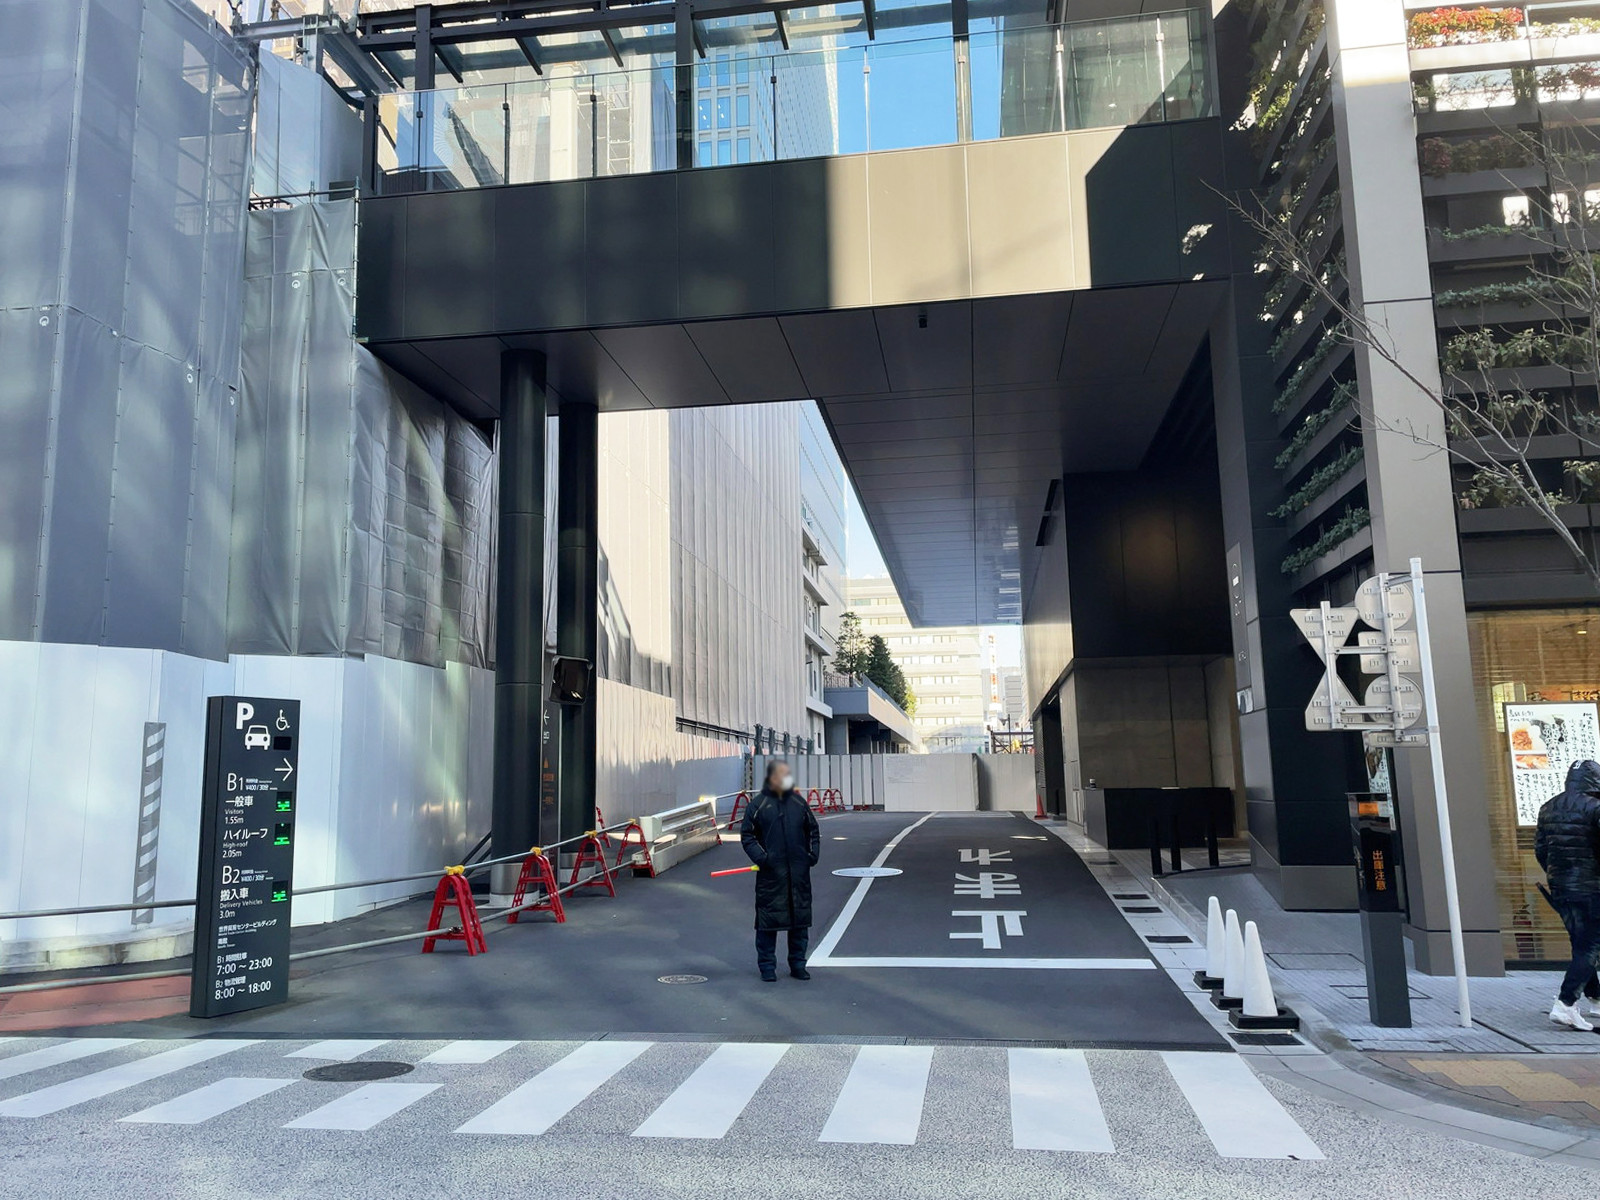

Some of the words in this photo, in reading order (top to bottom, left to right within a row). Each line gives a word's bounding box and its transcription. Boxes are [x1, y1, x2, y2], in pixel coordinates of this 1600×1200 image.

[236, 702, 254, 730] P
[227, 772, 243, 791] B1
[225, 795, 254, 807] 一般車
[224, 816, 244, 824] 1.55m
[223, 828, 268, 840] ハイルーフ
[222, 841, 248, 849] High-roof
[222, 850, 242, 858] 2.05m
[222, 865, 240, 885] B2
[220, 887, 249, 902] 搬入車
[219, 910, 236, 918] 3.0m
[216, 955, 225, 964] B1
[216, 963, 236, 975] 7:00
[248, 957, 273, 970] 23:00
[214, 987, 235, 1000] 8:00
[248, 980, 272, 994] 18:00
[215, 980, 224, 988] B2
